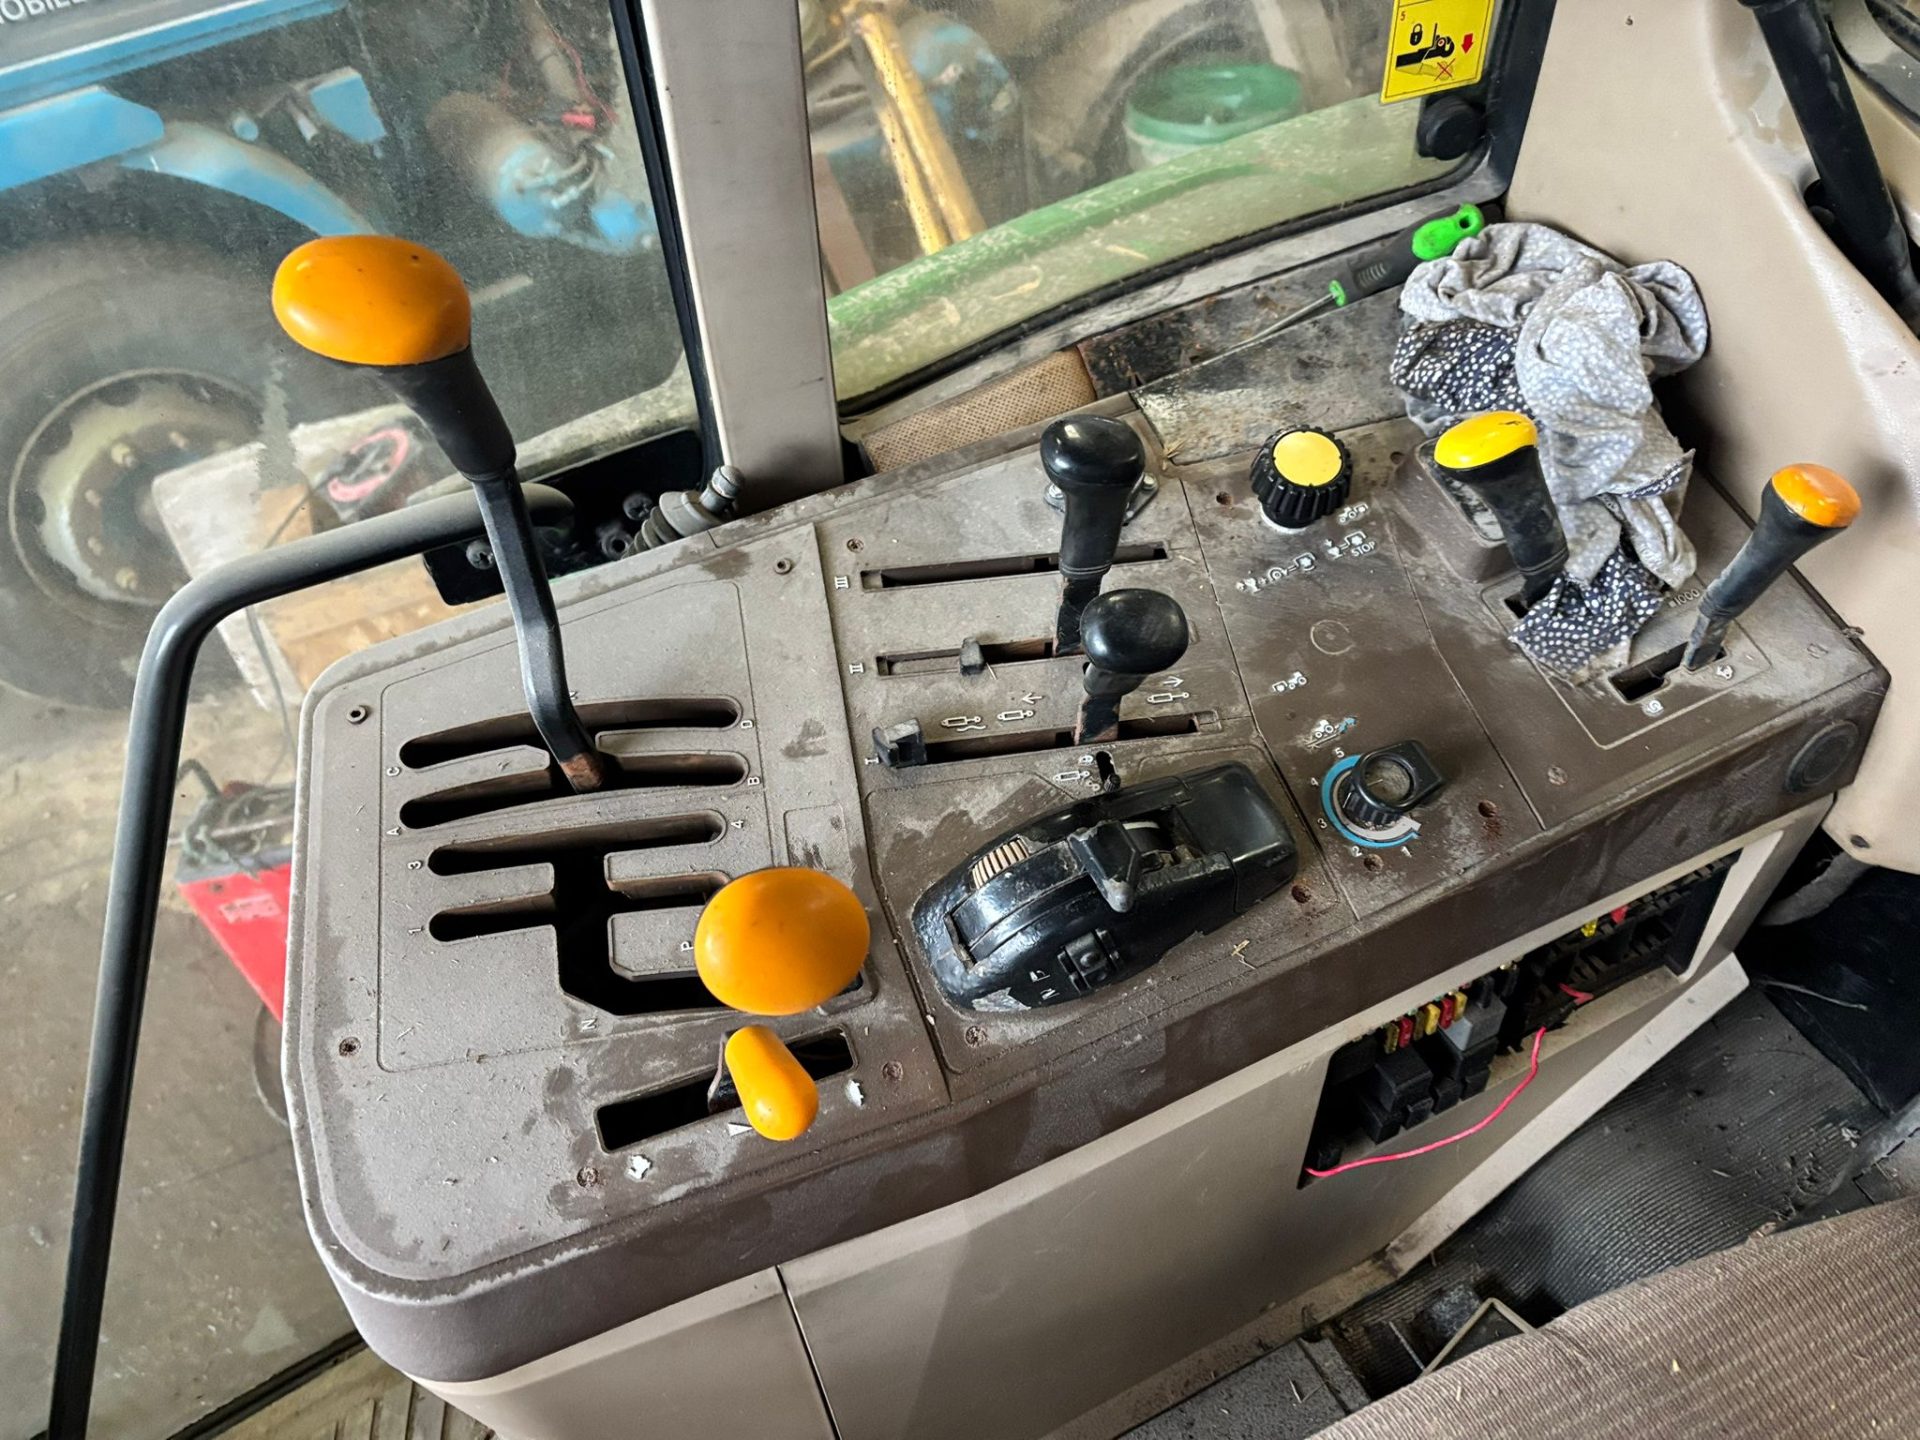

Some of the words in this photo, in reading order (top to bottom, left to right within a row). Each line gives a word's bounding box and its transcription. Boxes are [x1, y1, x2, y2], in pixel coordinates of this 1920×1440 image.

[1400, 11, 1406, 21] 5
[1351, 541, 1376, 558] STOP
[1674, 588, 1700, 606] 1000
[740, 719, 753, 729] D
[1335, 747, 1345, 758] 5
[387, 766, 400, 777] C
[748, 776, 761, 786] B
[1310, 777, 1319, 787] 4
[730, 819, 744, 829] 4
[1317, 818, 1328, 829] 3
[387, 826, 400, 836] A
[1351, 846, 1363, 857] 2
[1401, 846, 1413, 858] 1
[407, 860, 422, 870] 3
[408, 926, 423, 936] 1
[680, 940, 694, 951] P
